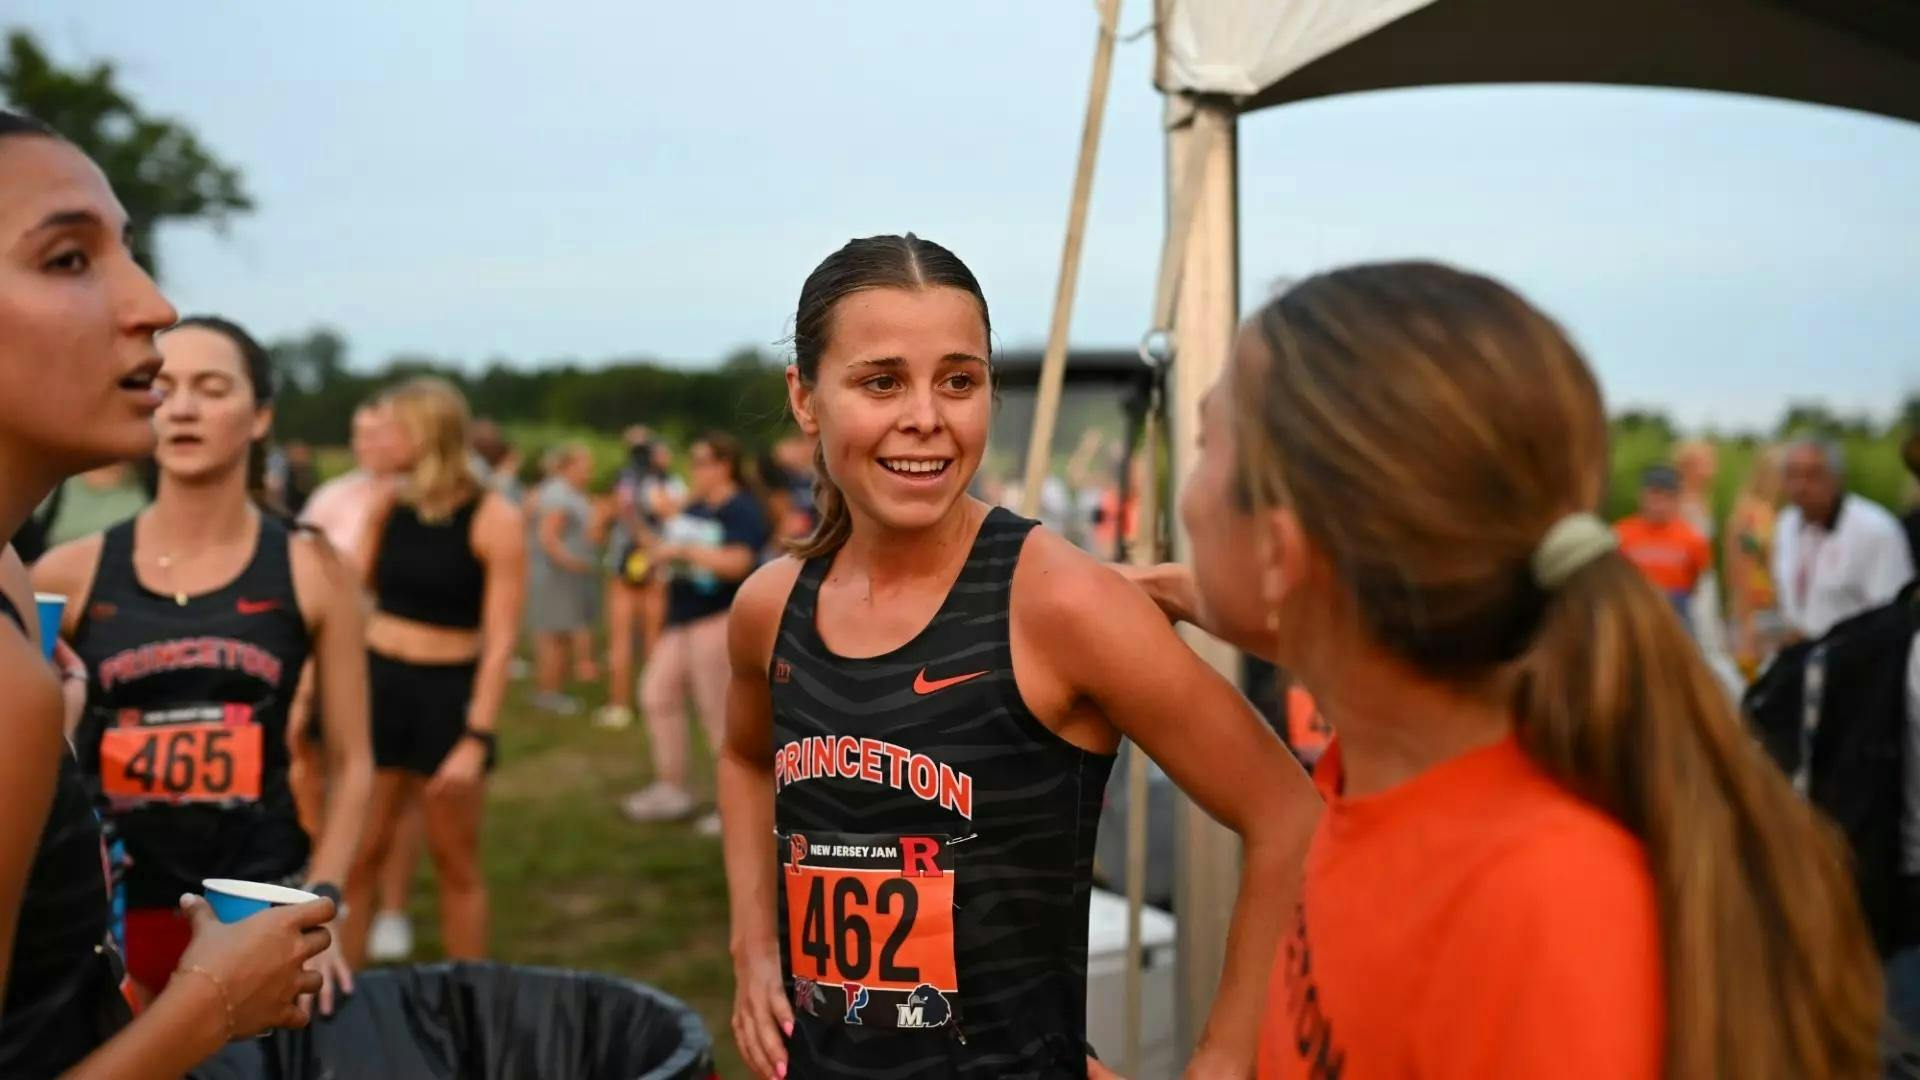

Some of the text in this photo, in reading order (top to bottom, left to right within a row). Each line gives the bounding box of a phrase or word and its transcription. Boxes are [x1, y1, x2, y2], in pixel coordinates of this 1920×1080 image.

[99, 636, 282, 691] PRINCETON
[124, 731, 234, 793] 465
[775, 735, 972, 820] PRINCETON
[810, 844, 897, 858] NEW JERSEY JAM
[899, 836, 943, 877] R
[801, 875, 920, 983] 462
[842, 982, 869, 1025] P
[896, 1004, 924, 1027] M
